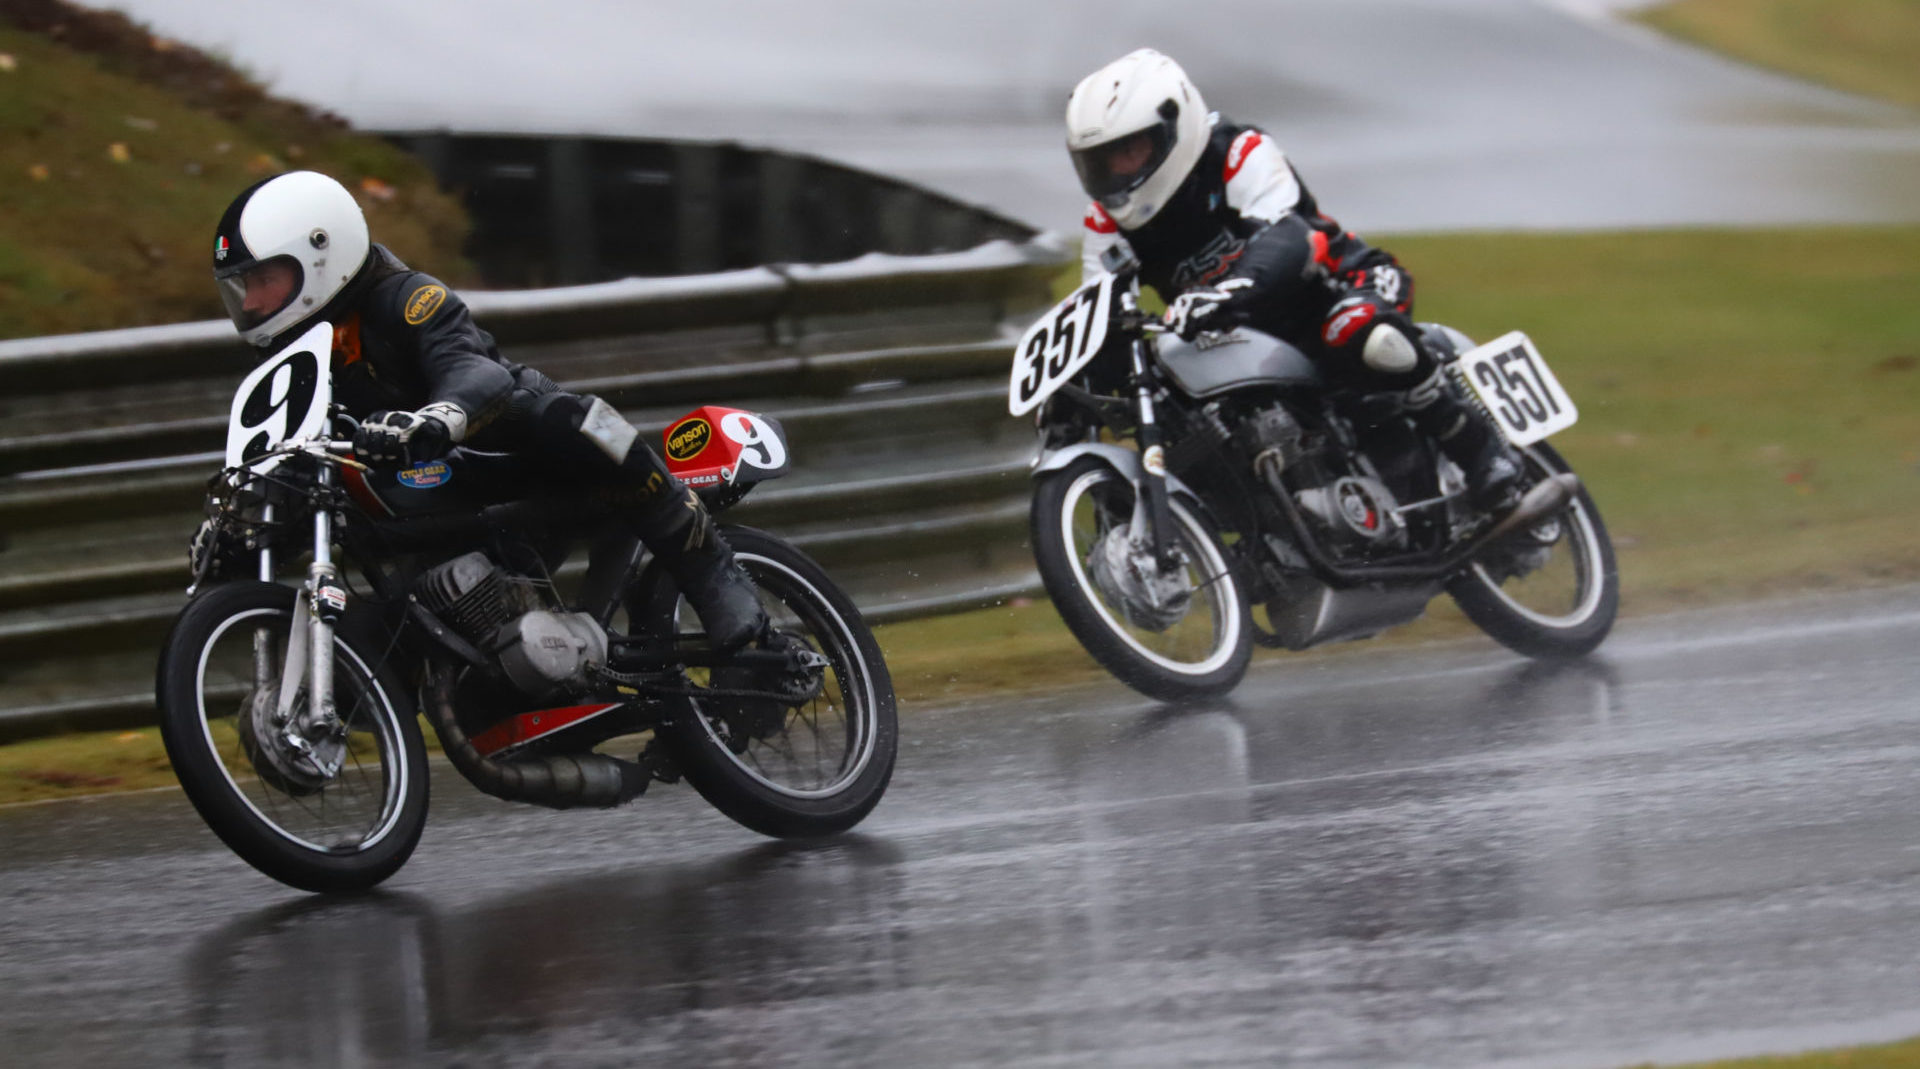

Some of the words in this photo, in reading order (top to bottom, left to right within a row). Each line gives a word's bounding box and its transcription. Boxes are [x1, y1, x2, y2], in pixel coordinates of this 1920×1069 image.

[1020, 283, 1101, 402] 357
[241, 351, 318, 466] 9
[1474, 345, 1561, 431] 357
[668, 424, 706, 451] vanson
[721, 413, 786, 469] 9
[424, 465, 446, 475] GEAR
[692, 475, 718, 484] GEAR
